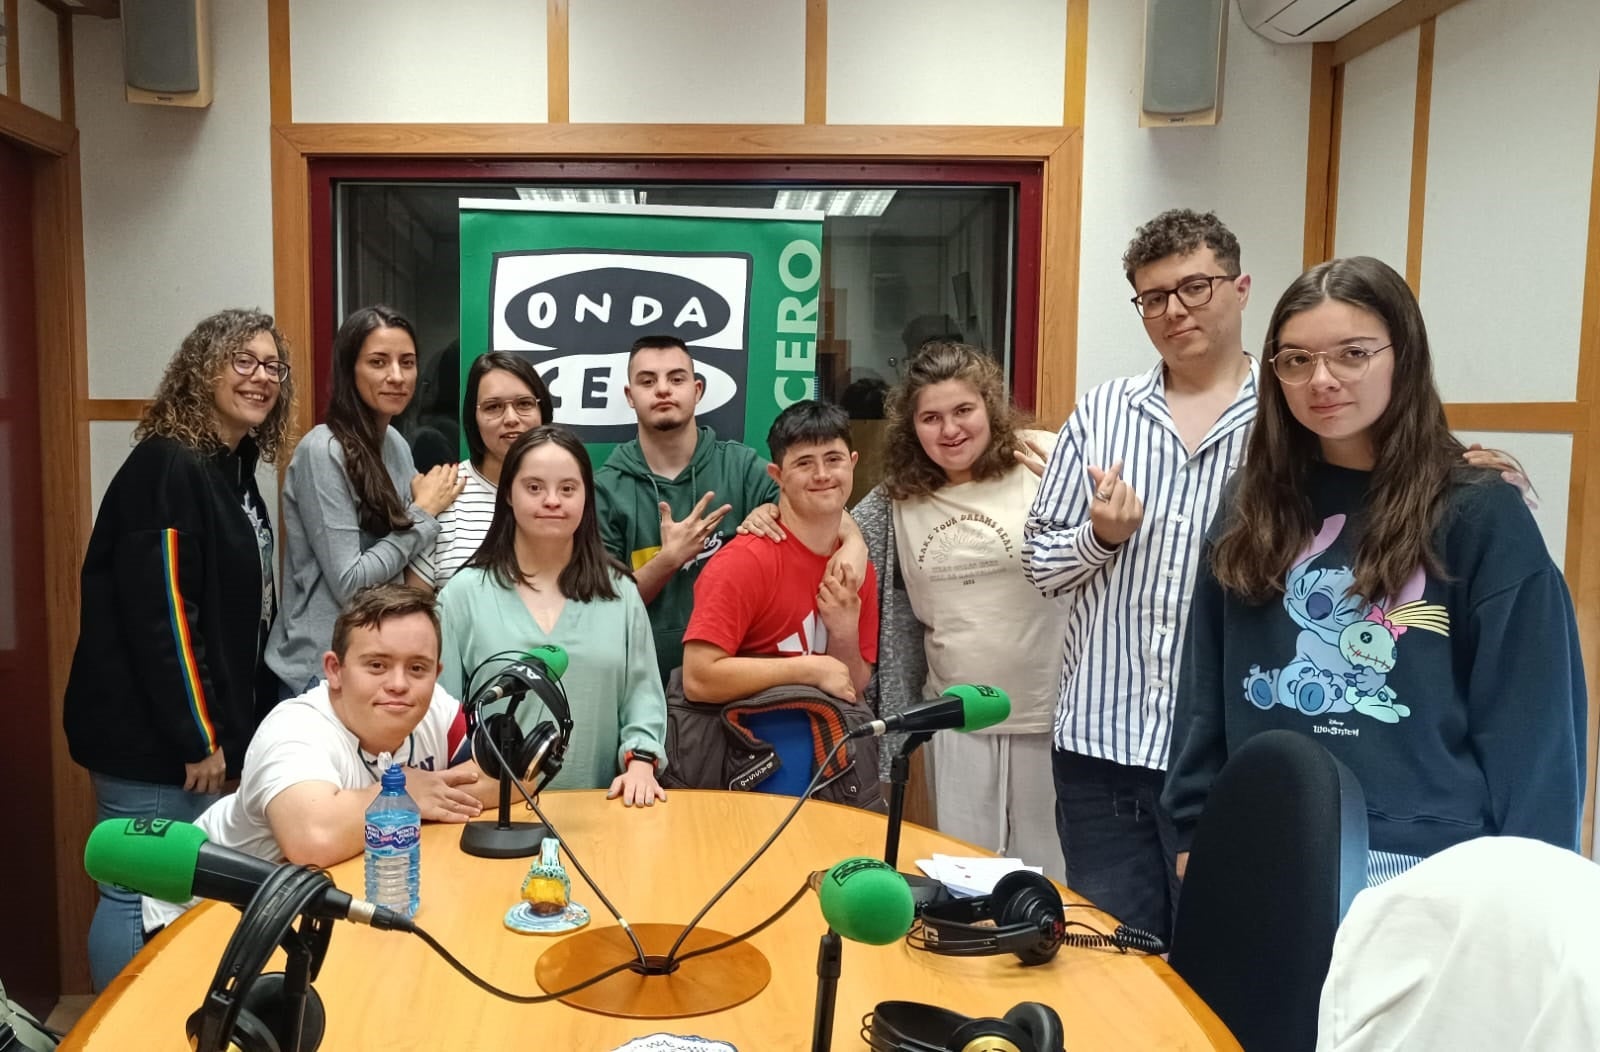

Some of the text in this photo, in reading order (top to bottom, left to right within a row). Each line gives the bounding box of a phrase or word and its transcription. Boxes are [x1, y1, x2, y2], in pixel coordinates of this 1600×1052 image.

[527, 291, 708, 329] ONDA
[774, 239, 821, 411] CERO
[918, 514, 1014, 563] MAKE YOUR DREAMS REAL
